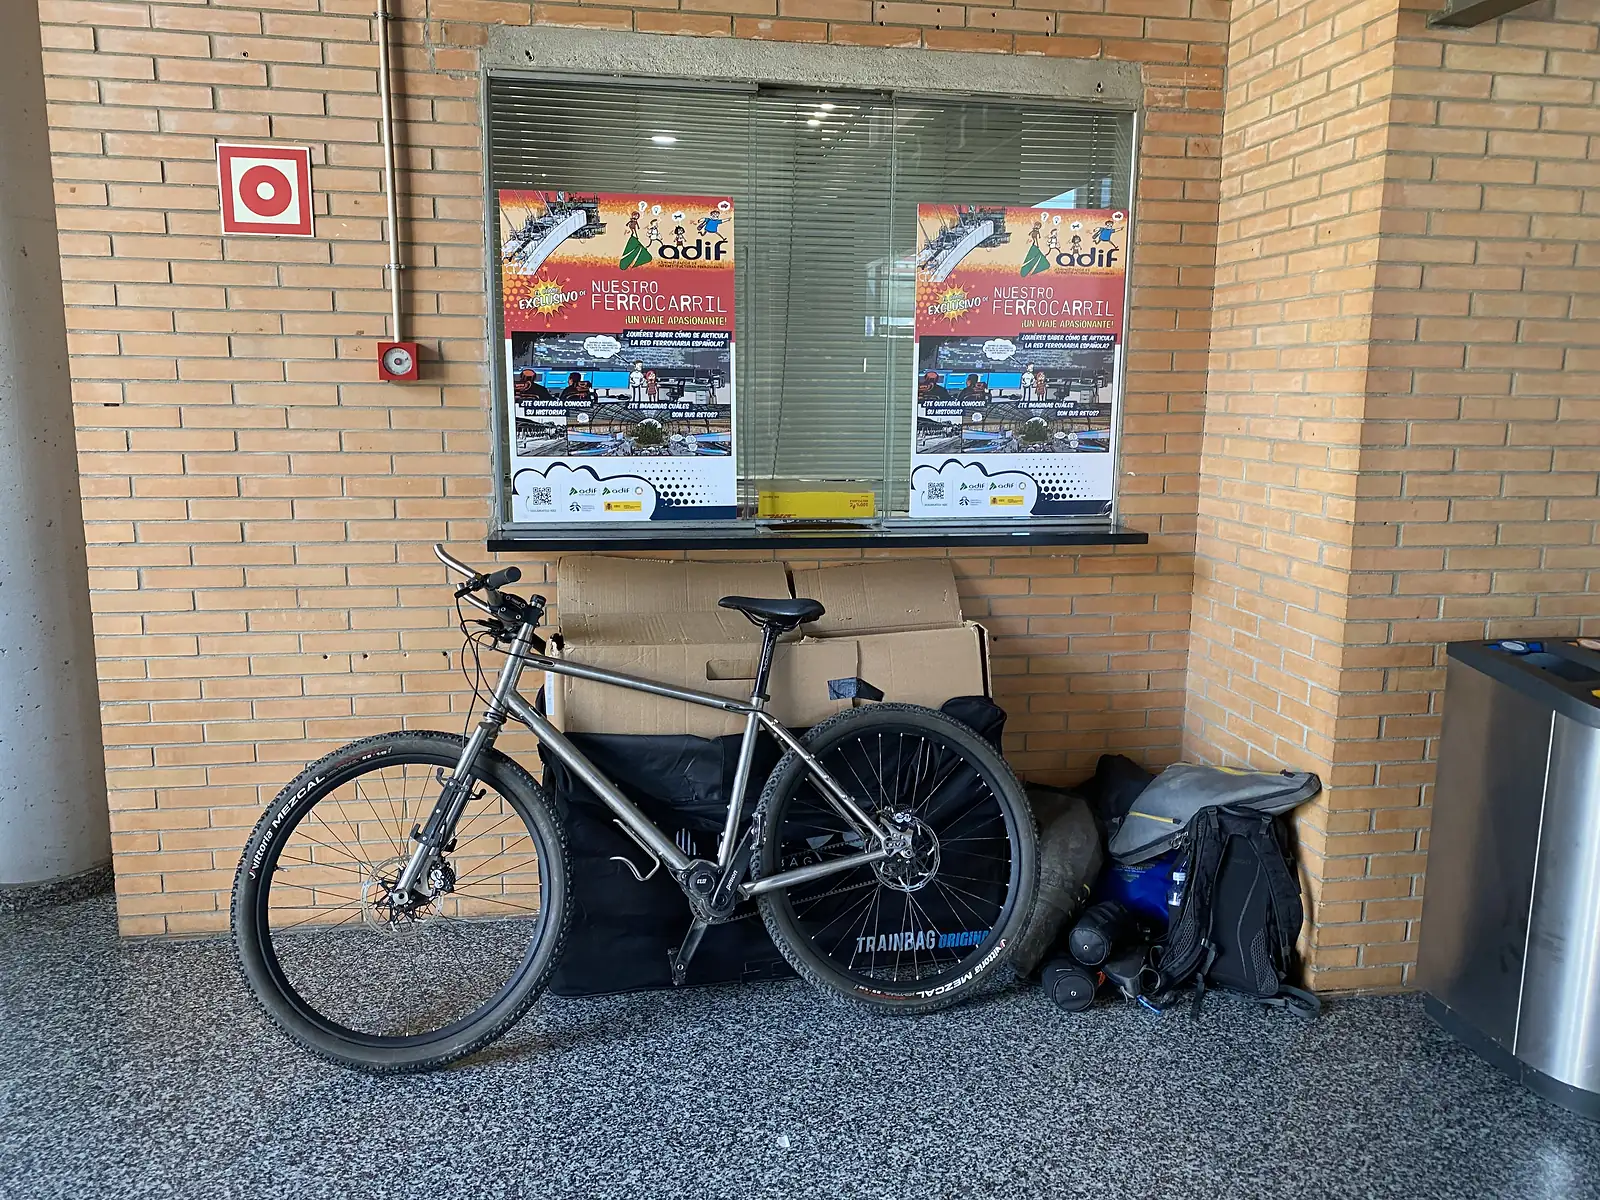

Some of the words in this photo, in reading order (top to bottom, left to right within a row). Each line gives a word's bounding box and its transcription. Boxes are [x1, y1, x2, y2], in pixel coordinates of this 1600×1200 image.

[658, 239, 729, 261] adif
[1056, 247, 1120, 267] adif
[591, 280, 659, 294] NUESTRO
[993, 286, 1054, 299] NUESTRO
[519, 291, 578, 310] EXCLUSIVO
[591, 293, 728, 313] FERROCARRIL
[928, 297, 981, 316] EXCLUSIVO
[992, 299, 1115, 316] FERROCARRIL
[625, 316, 640, 324] ¡UN
[1021, 320, 1035, 328] ¡UN
[674, 330, 692, 339] CÓMO
[701, 331, 729, 340] ARTICULA
[630, 339, 639, 347] LA
[639, 339, 652, 347] RED
[652, 340, 690, 348] FERROVIARIA
[520, 400, 533, 408] ¿TE
[564, 399, 592, 408] CONOCER
[961, 400, 986, 408] CONOCER
[525, 408, 535, 416] SU
[535, 408, 567, 417] HISTORIA?
[696, 411, 718, 419] RETOS?
[271, 775, 326, 829] MEZCAL
[725, 869, 739, 891] pinion
[856, 930, 936, 953] TRAINBAG
[916, 973, 974, 999] MEZCAL
